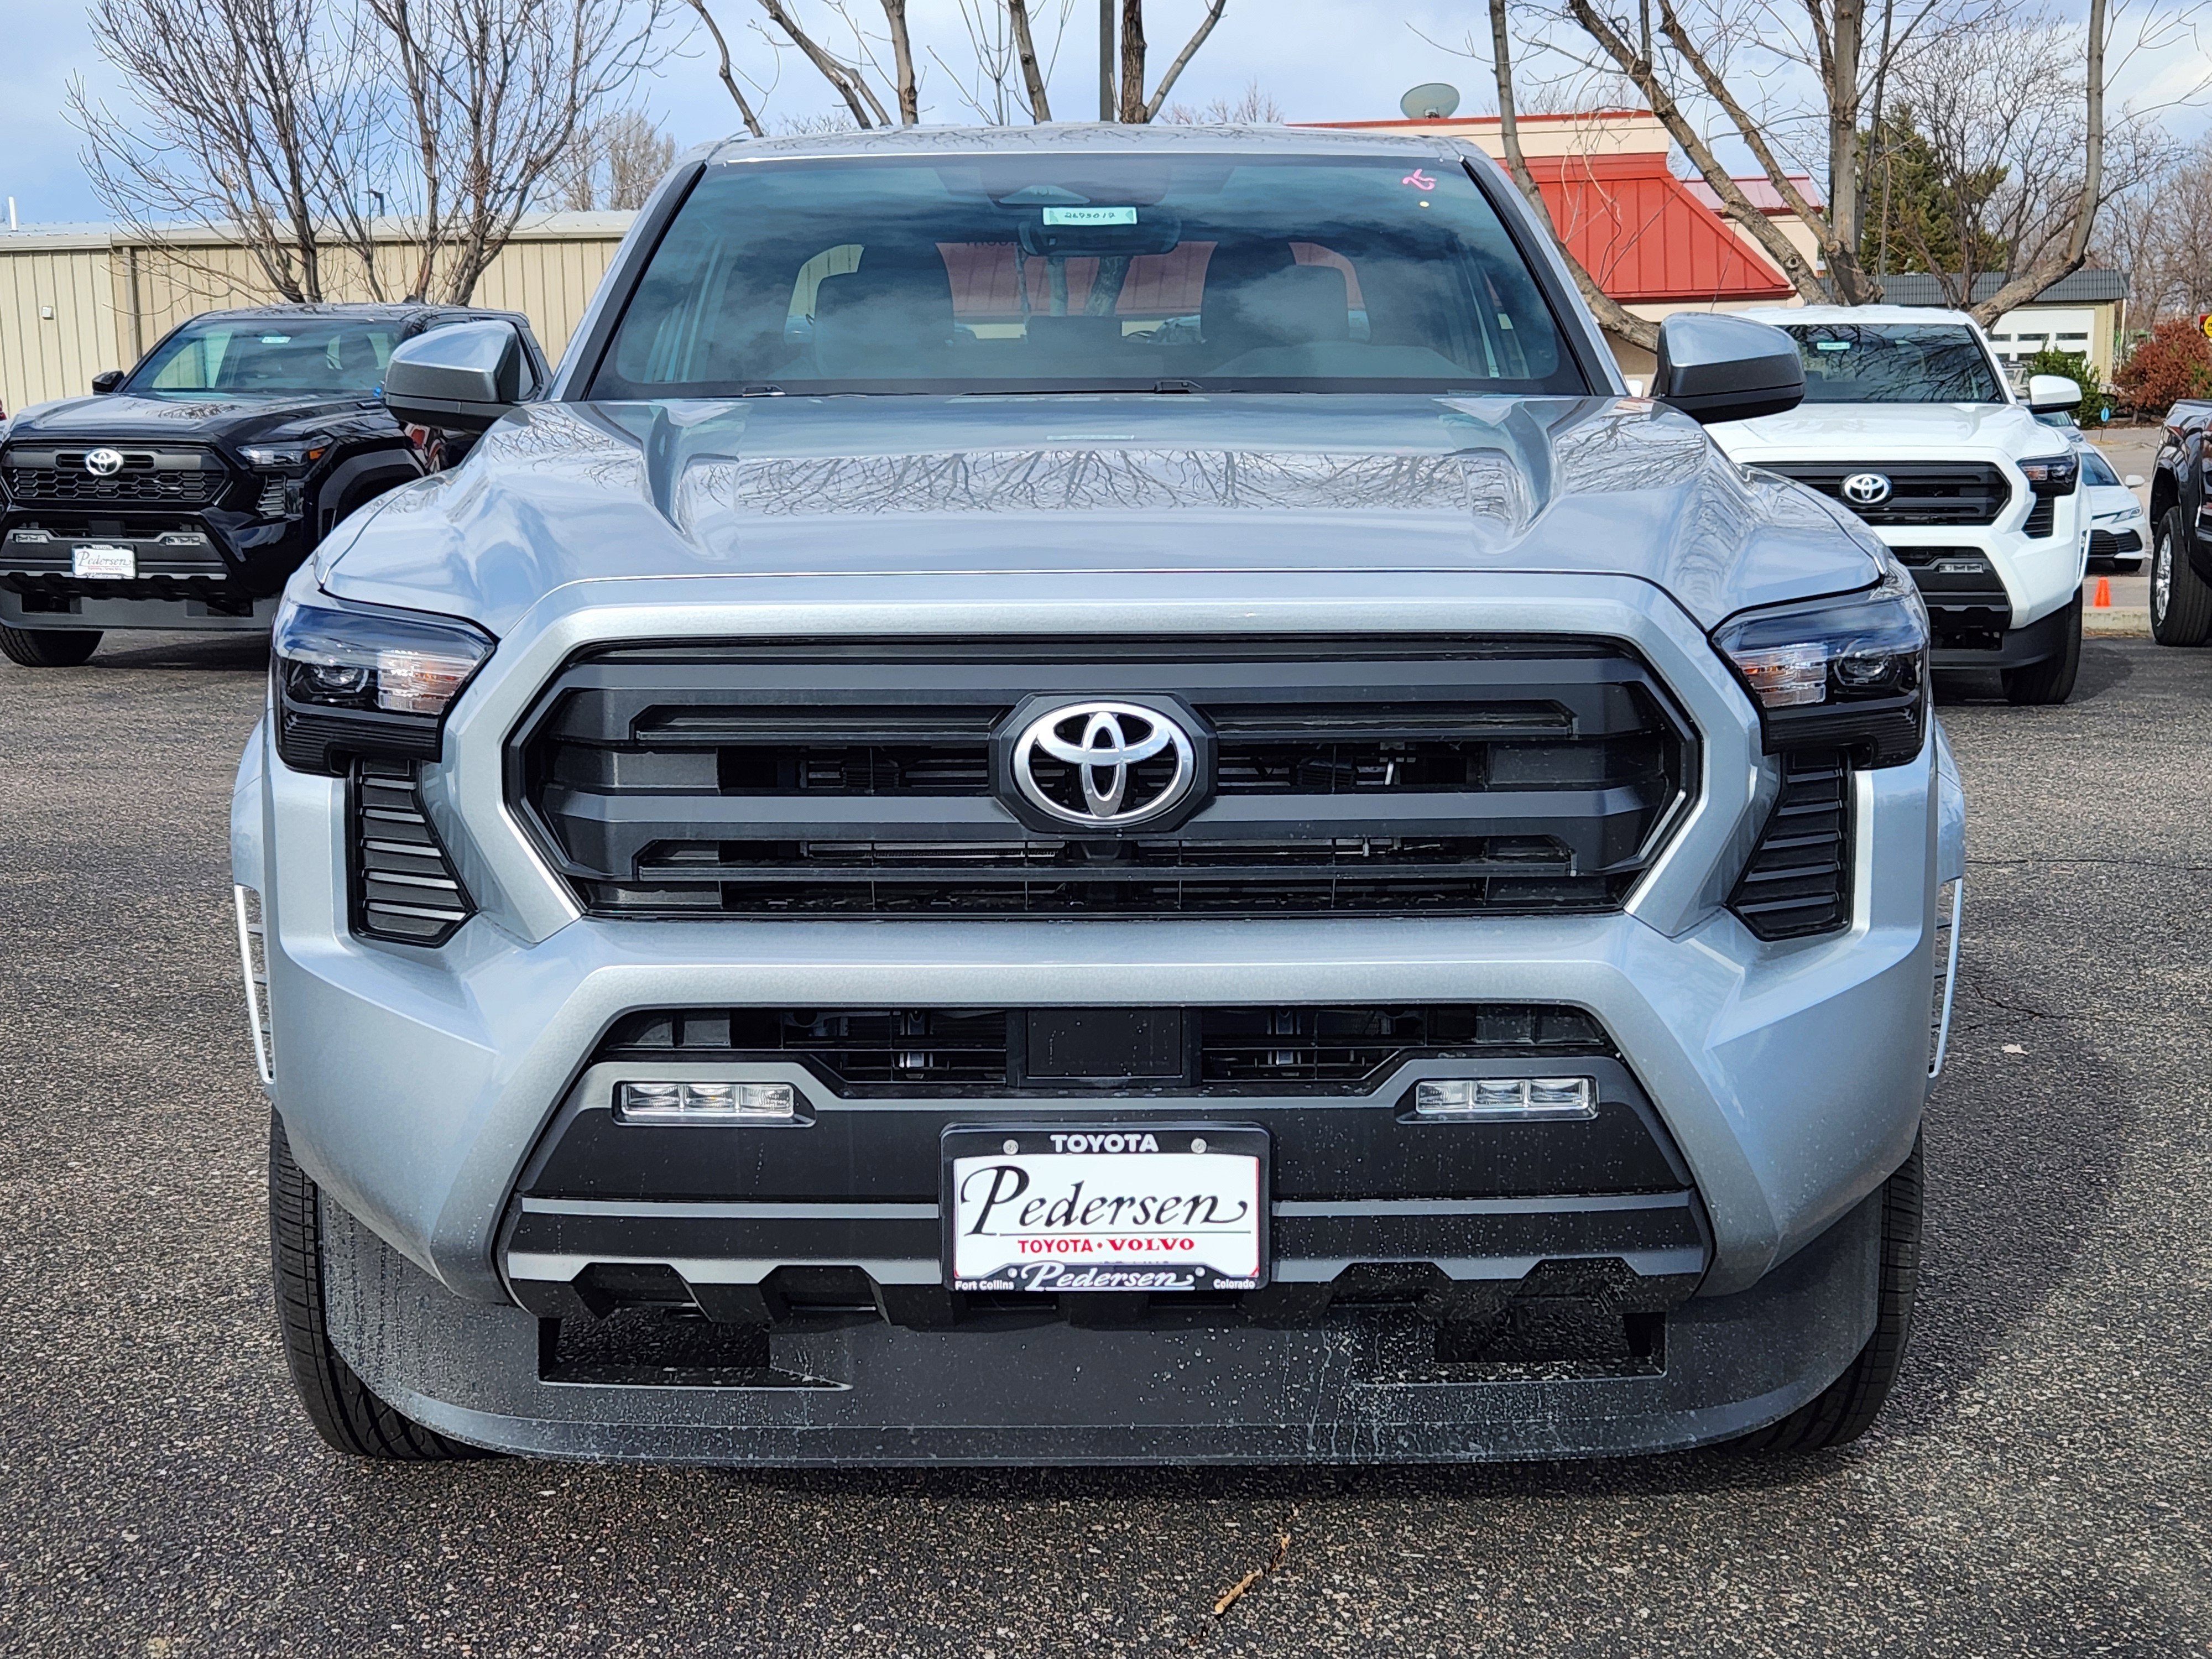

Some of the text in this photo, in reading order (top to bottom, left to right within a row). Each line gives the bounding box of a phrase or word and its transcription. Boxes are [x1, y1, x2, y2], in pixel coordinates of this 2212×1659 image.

[76, 551, 132, 567] Pedersen
[1050, 1134, 1159, 1153] TOYOTA
[960, 1165, 1248, 1236] Pedersen
[1018, 1238, 1194, 1254] TOYOTA VOLVO
[1020, 1260, 1196, 1291] Pedersen
[954, 1279, 1014, 1291] Fort Collins
[1213, 1279, 1256, 1290] Colorado
